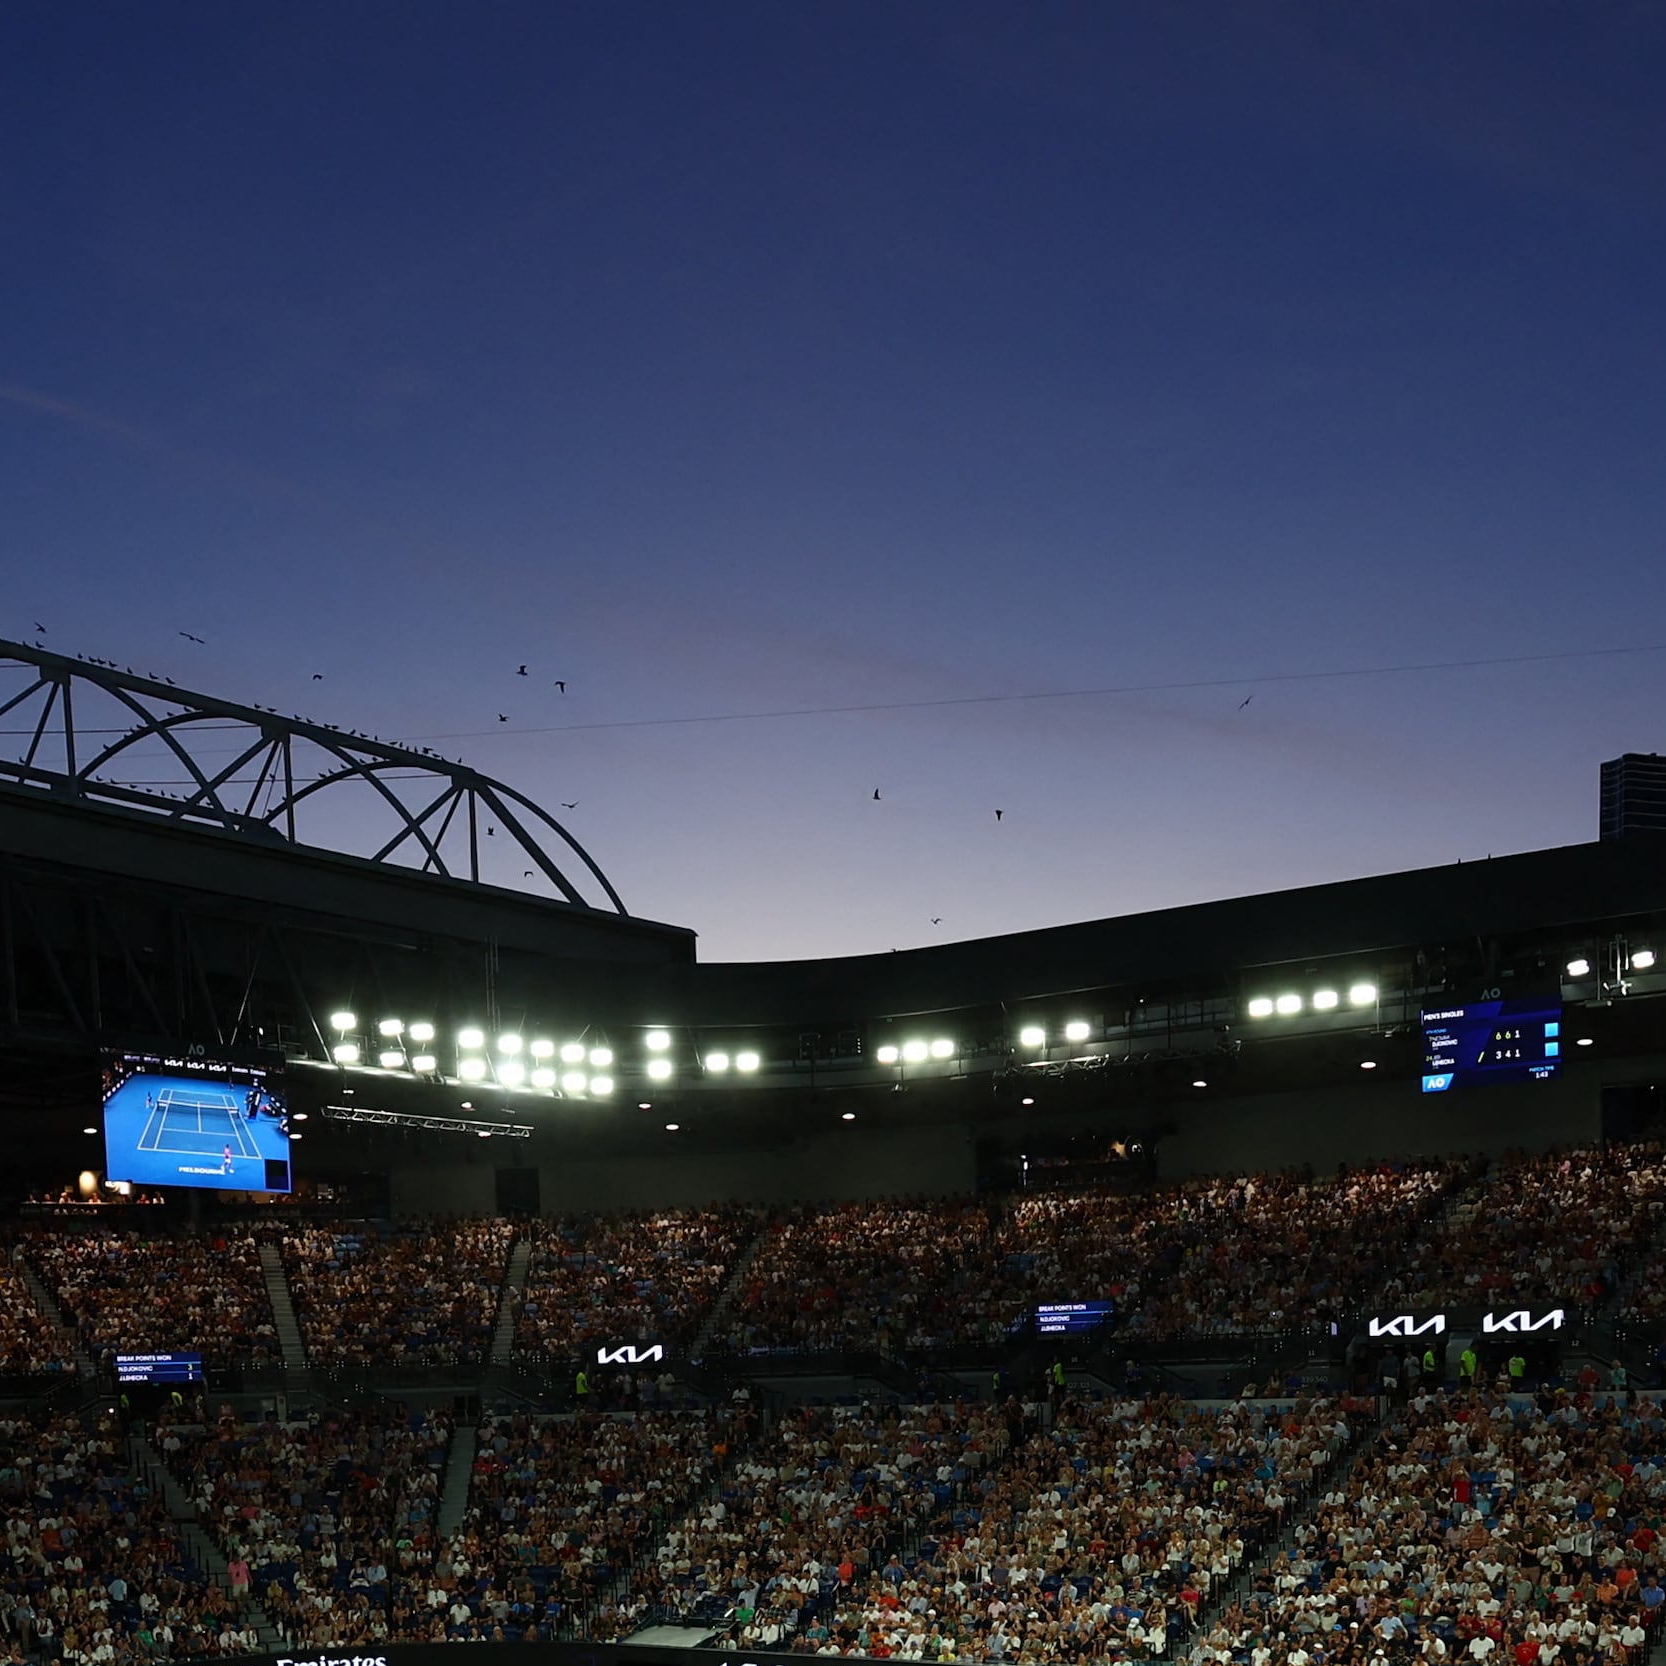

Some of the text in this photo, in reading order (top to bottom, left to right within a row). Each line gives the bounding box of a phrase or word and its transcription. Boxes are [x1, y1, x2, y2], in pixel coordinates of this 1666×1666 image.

[1496, 1029, 1520, 1040] 6 6 1
[1496, 1049, 1520, 1059] 3 4 1
[1369, 1315, 1445, 1336] KIA
[1483, 1310, 1564, 1332] KIA
[598, 1345, 662, 1364] KIA
